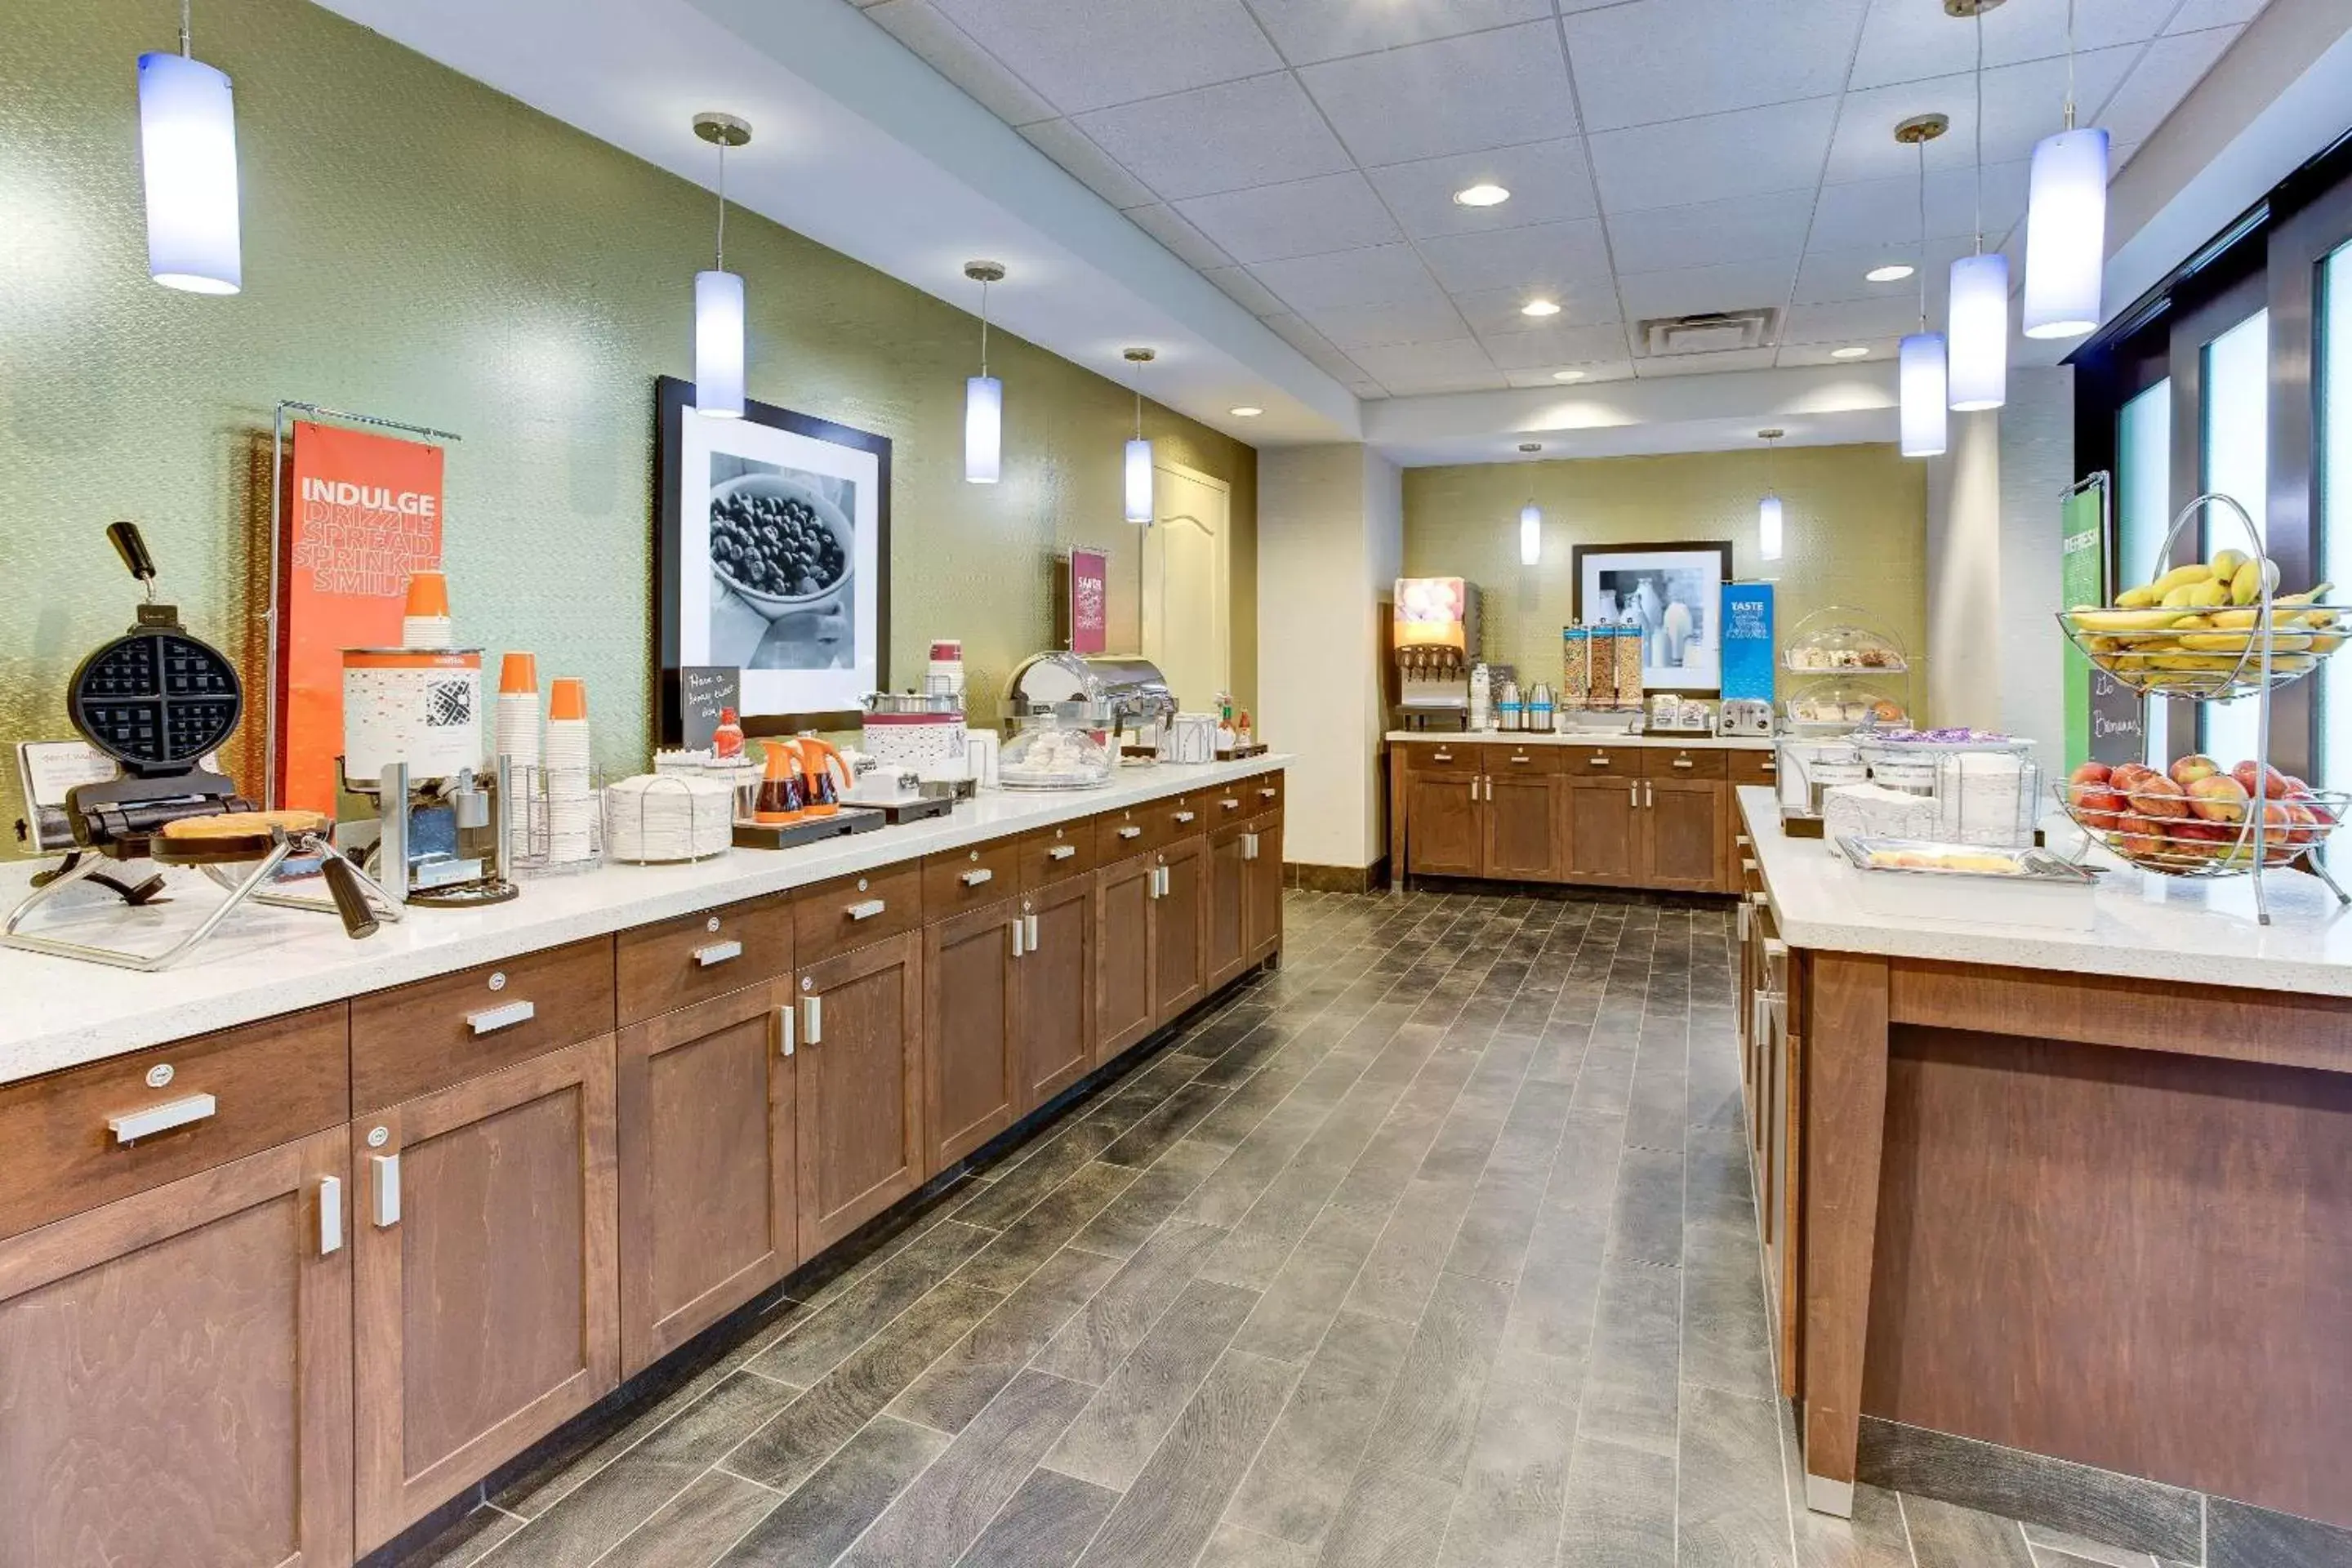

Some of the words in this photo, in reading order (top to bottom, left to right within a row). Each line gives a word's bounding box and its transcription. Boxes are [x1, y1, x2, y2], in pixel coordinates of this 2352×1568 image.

[301, 476, 436, 517] INDULGE
[303, 501, 434, 537] DRIZZLE
[302, 522, 434, 557] SPREAD
[292, 542, 443, 576] SPRINKLE
[1731, 601, 1764, 611] TASTE
